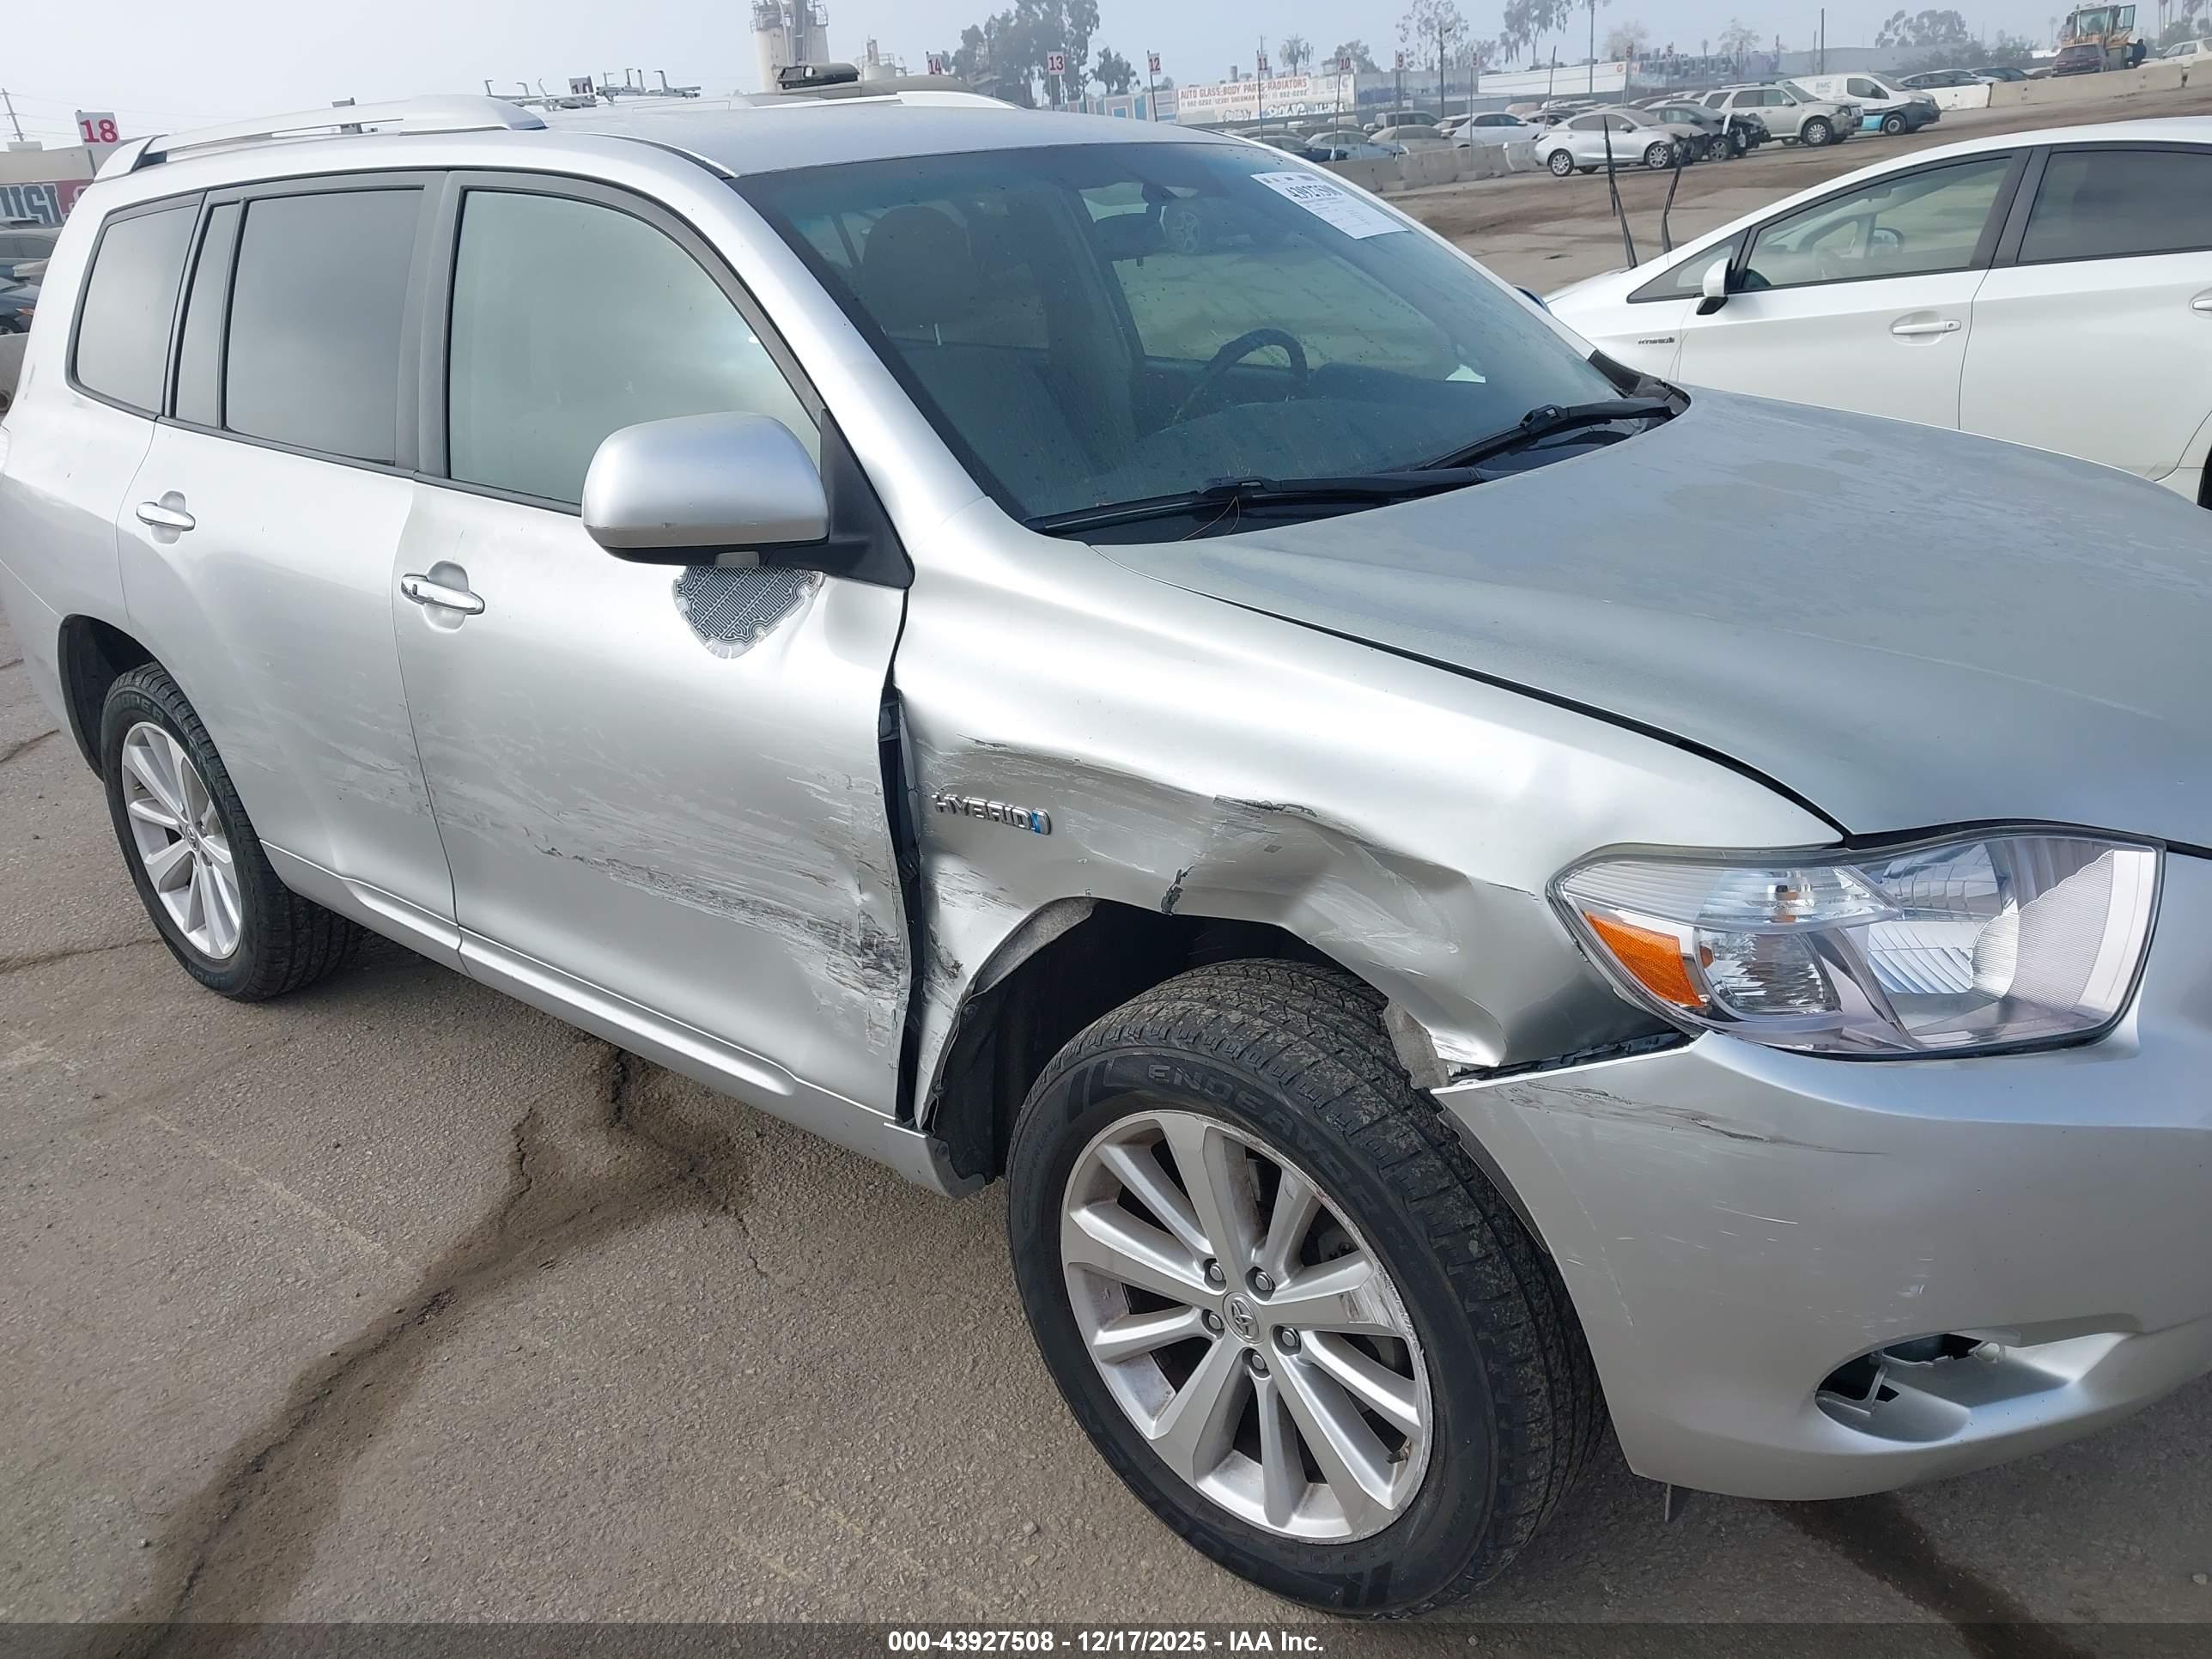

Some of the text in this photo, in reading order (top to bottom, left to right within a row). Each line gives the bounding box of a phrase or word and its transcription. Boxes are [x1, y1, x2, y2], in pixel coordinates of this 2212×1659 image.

[928, 58, 942, 76] 14
[1048, 55, 1064, 70] 13
[1149, 57, 1161, 71] 12
[1258, 57, 1268, 71] 11
[1340, 57, 1351, 70] 10
[1181, 88, 1198, 100] AUTO
[80, 118, 118, 143] 18
[932, 792, 1033, 831] HYBRID
